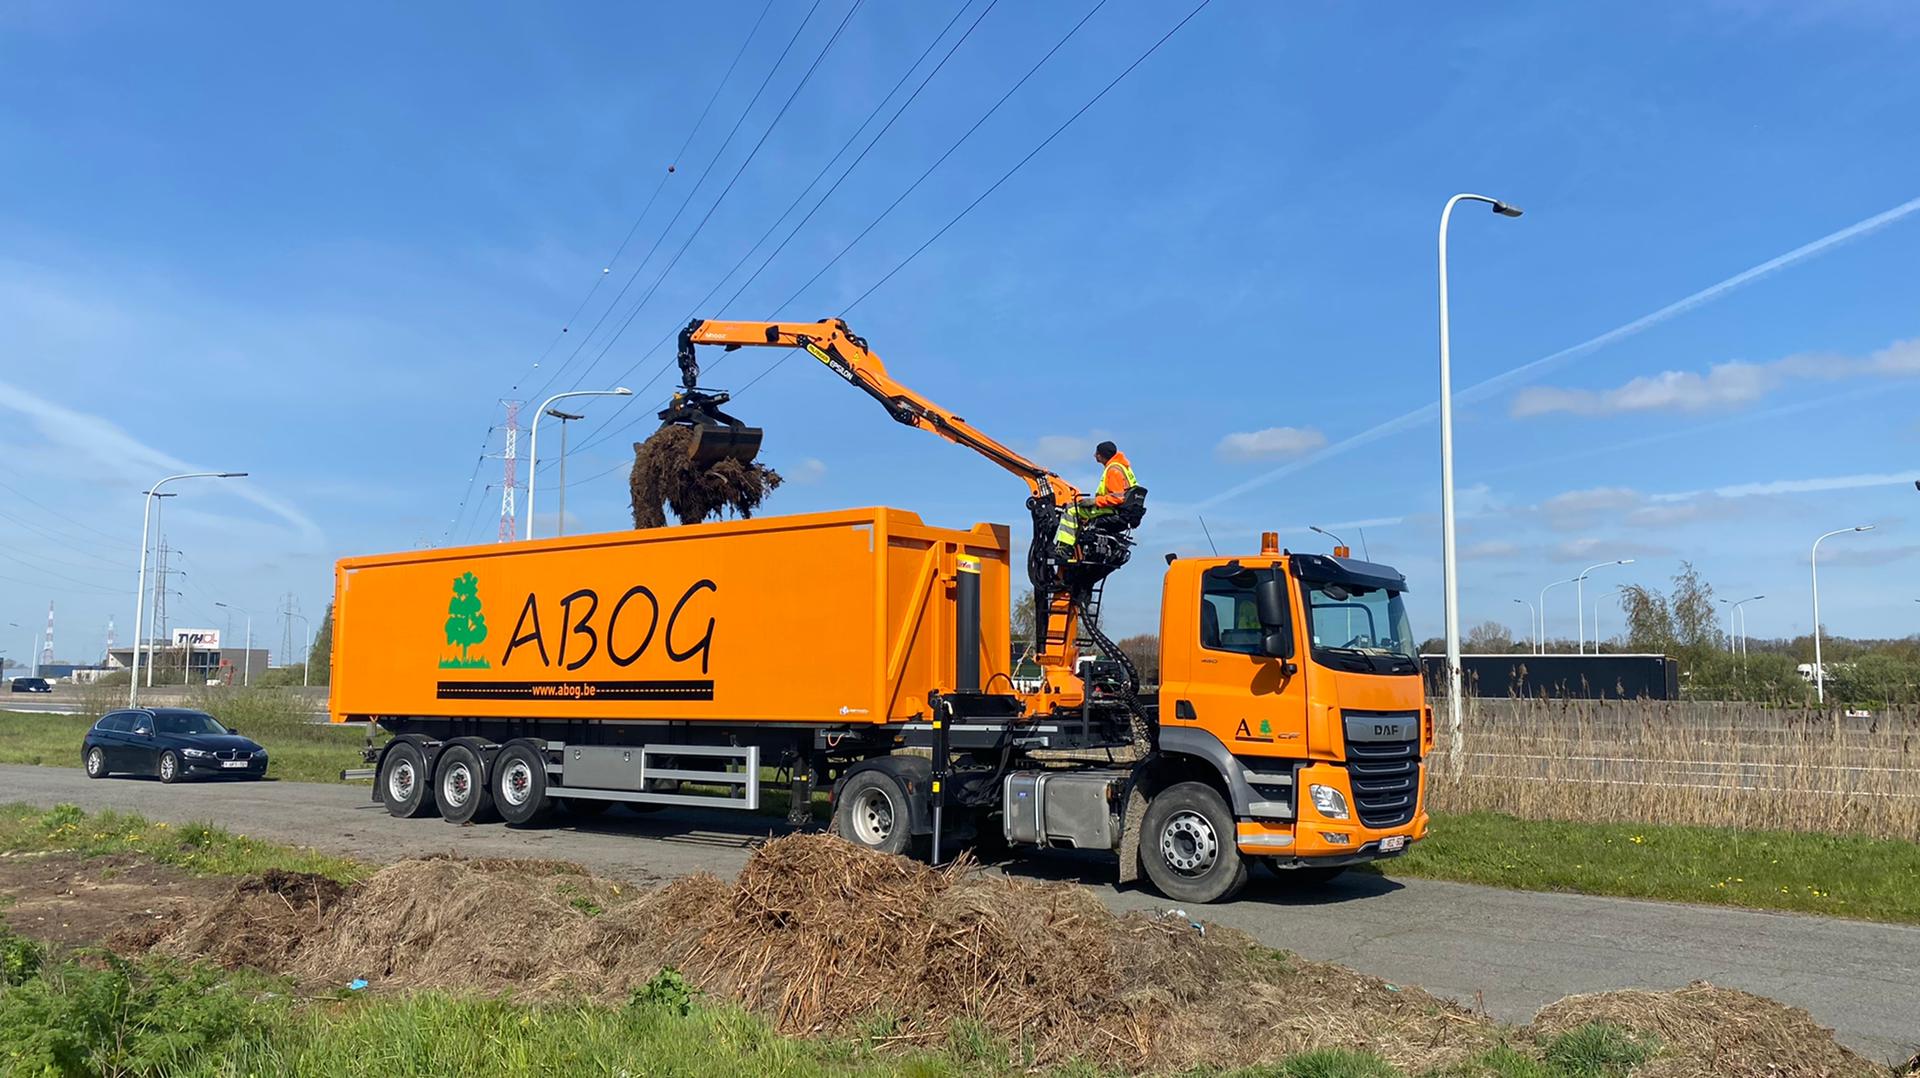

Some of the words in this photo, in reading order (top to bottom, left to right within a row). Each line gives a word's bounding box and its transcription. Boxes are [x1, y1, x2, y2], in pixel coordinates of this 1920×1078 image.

[830, 360, 853, 380] EPSILON
[502, 579, 717, 674] ABOG
[178, 633, 204, 644] TVH
[532, 682, 596, 699] www.abog.be
[1235, 718, 1251, 737] A
[1374, 724, 1399, 736] DAF
